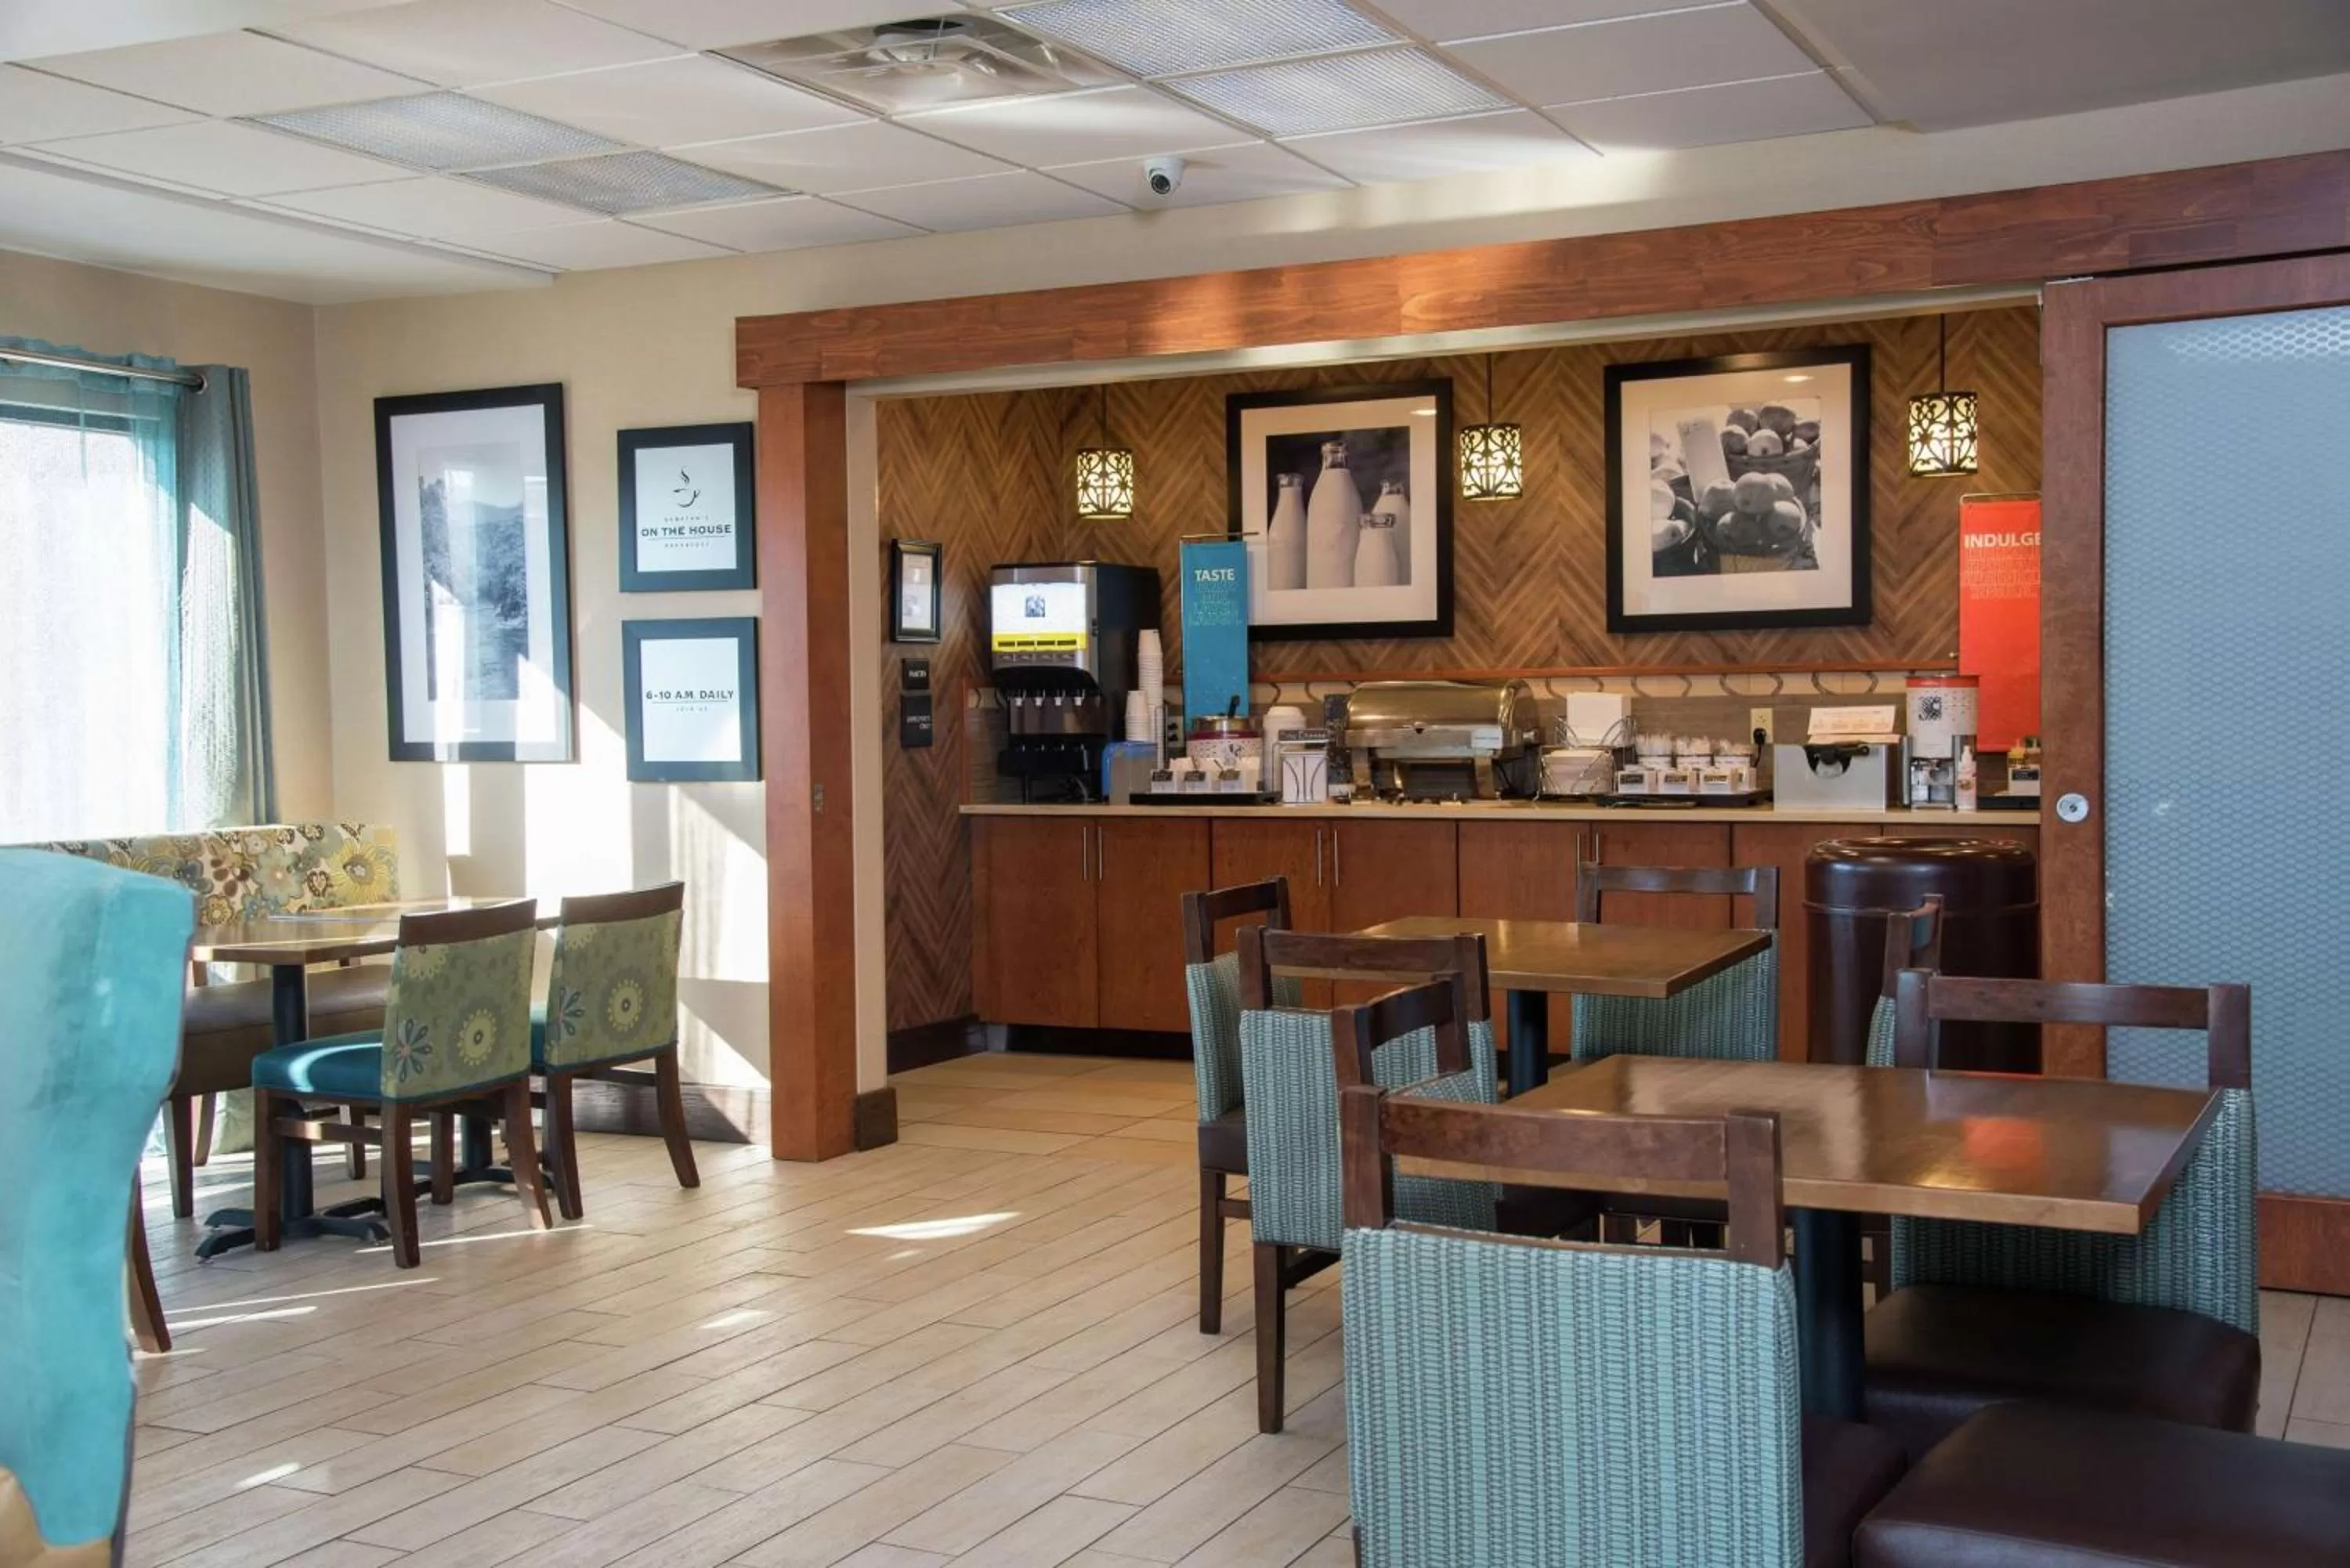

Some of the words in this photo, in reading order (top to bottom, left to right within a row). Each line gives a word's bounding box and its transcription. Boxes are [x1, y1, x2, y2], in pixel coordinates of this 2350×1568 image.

[641, 528, 658, 537] ON
[661, 526, 685, 536] THE
[689, 524, 732, 535] HOUSE
[1964, 532, 2041, 548] INDULGE
[1195, 569, 1235, 582] TASTE
[645, 690, 671, 699] 6-10
[700, 689, 734, 699] DAILY
